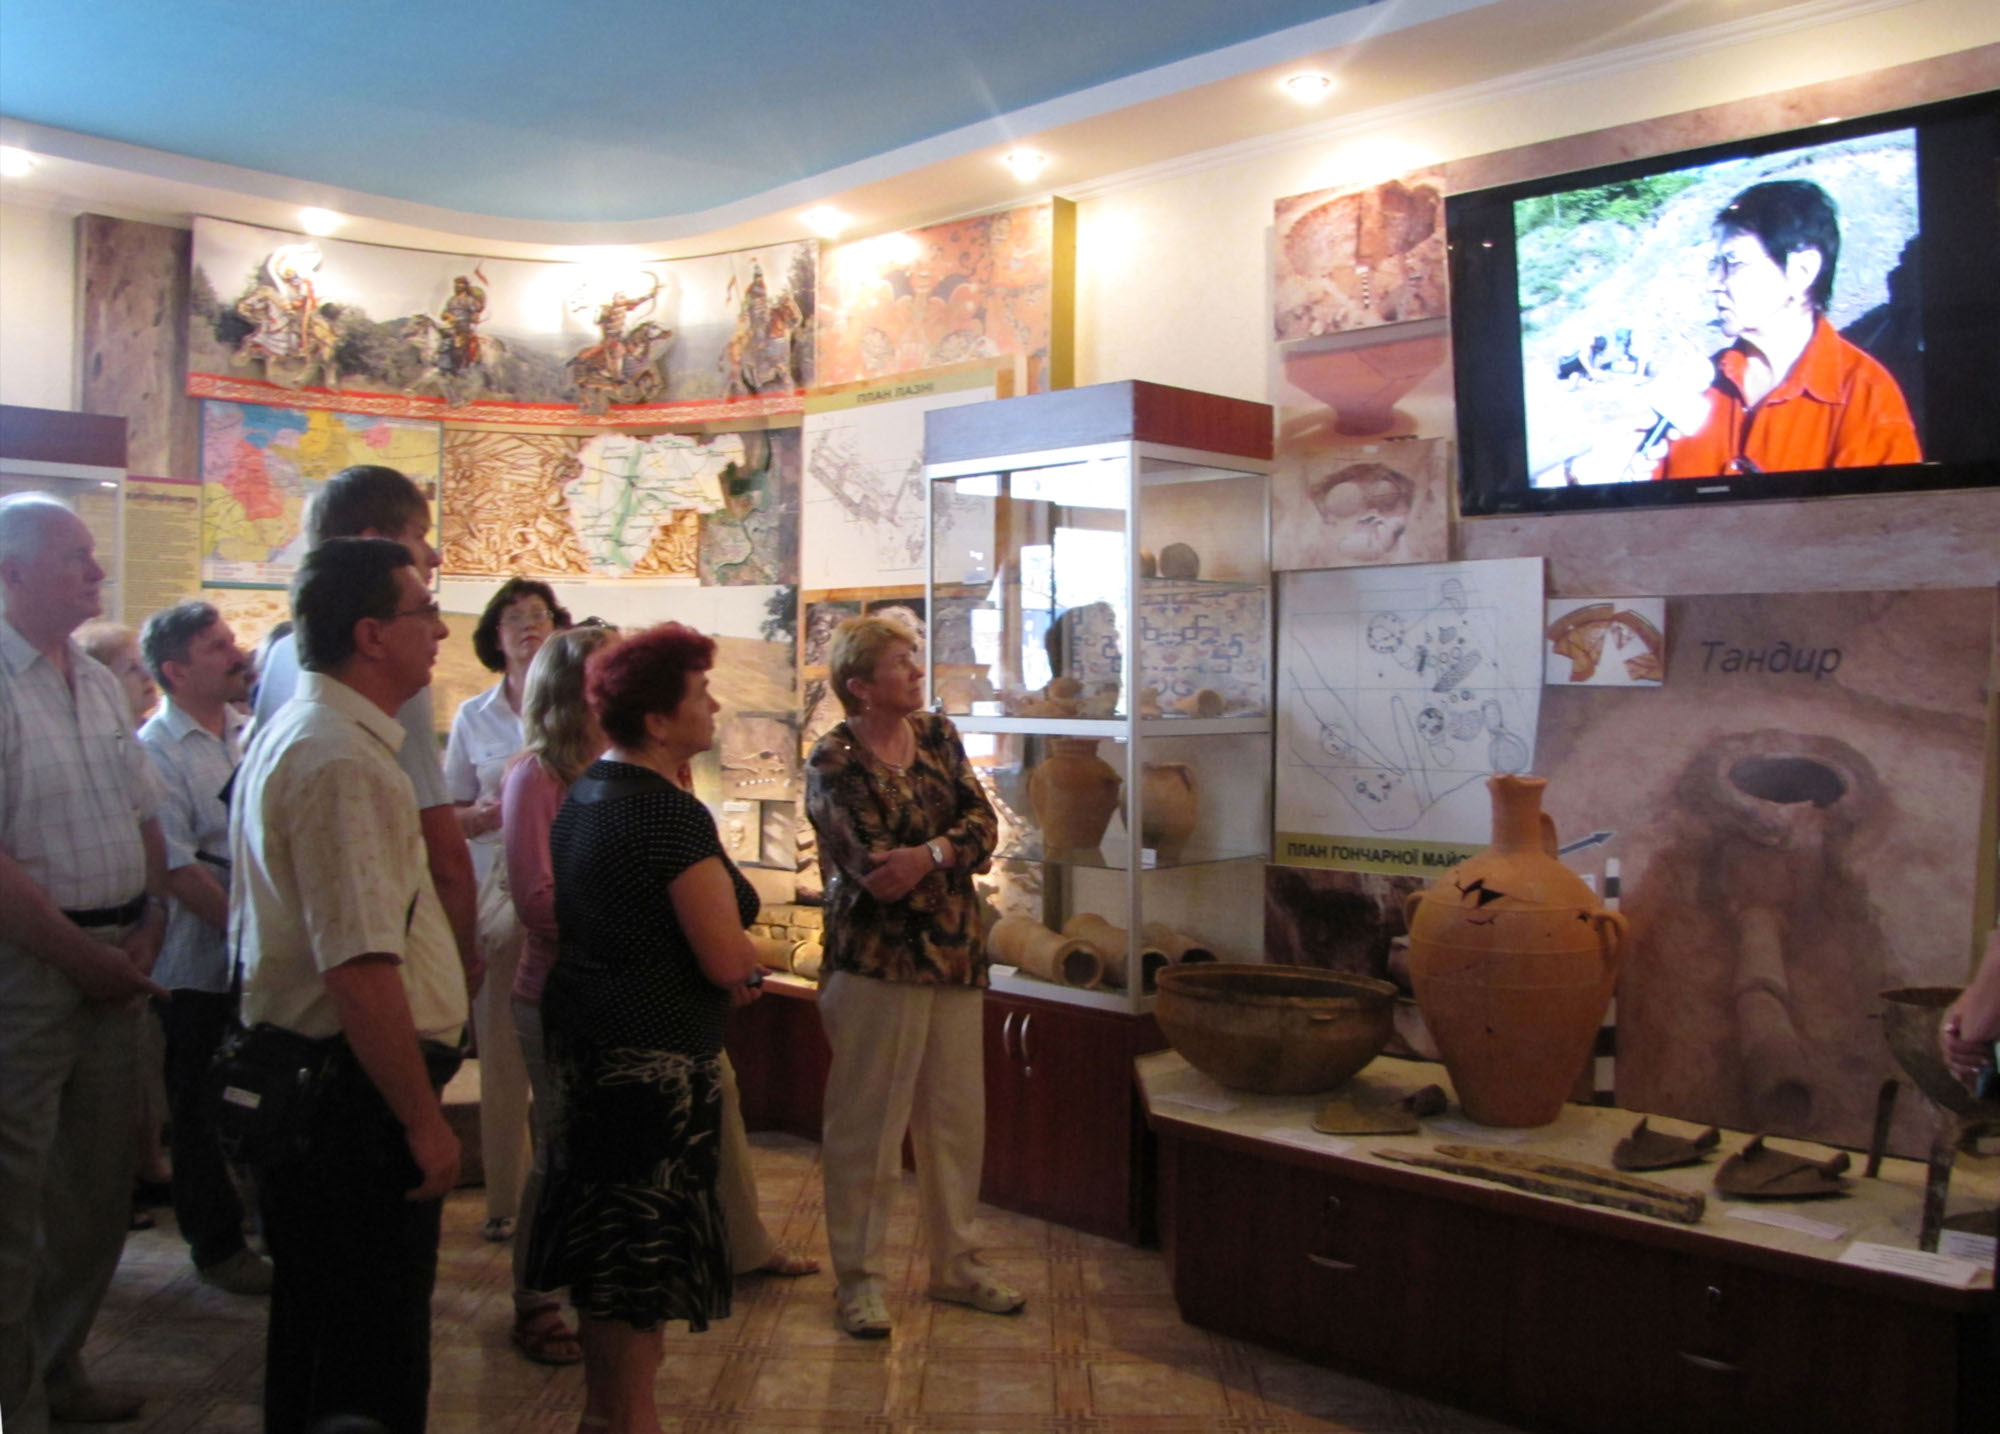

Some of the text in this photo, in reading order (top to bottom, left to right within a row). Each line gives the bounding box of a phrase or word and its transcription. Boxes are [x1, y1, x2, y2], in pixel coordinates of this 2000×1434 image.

[857, 390, 892, 403] ПЛАН
[1701, 641, 1842, 680] Тандир
[1287, 843, 1327, 858] ПЛАН
[1331, 846, 1419, 866] ГОНЧАРНОЇ
